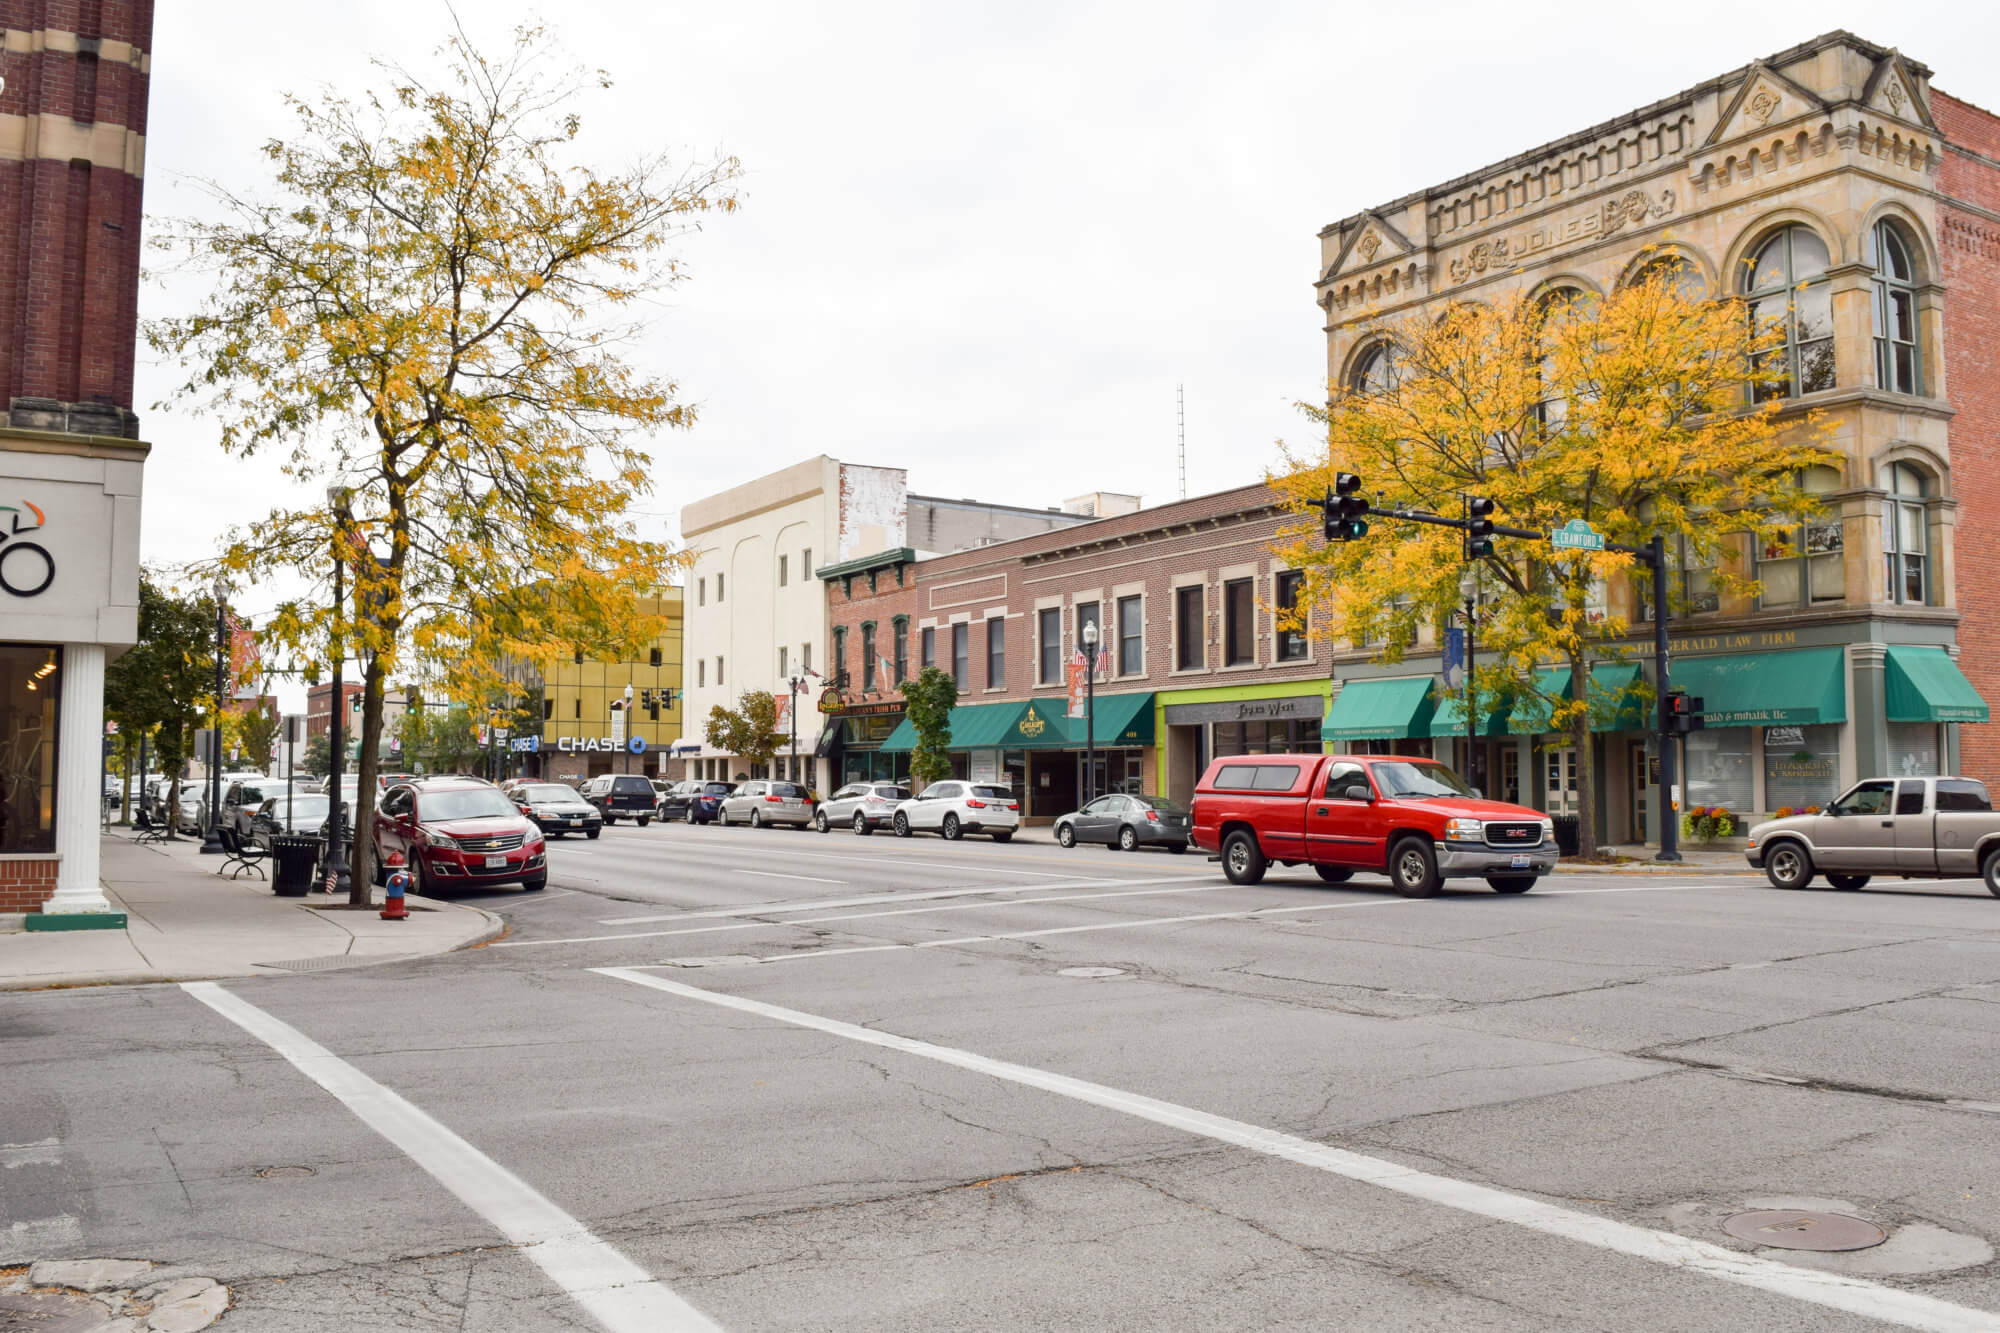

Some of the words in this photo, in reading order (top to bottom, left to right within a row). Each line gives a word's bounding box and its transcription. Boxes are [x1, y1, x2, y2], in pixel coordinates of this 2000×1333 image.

[1514, 214, 1598, 253] JONES
[1560, 532, 1597, 547] CRAWFORD
[1637, 637, 1718, 654] FITGERALD
[1726, 635, 1752, 648] LAW
[1761, 632, 1798, 646] FIRM
[511, 737, 533, 752] CHASE
[558, 736, 625, 752] CHASE
[1506, 829, 1528, 837] GMC
